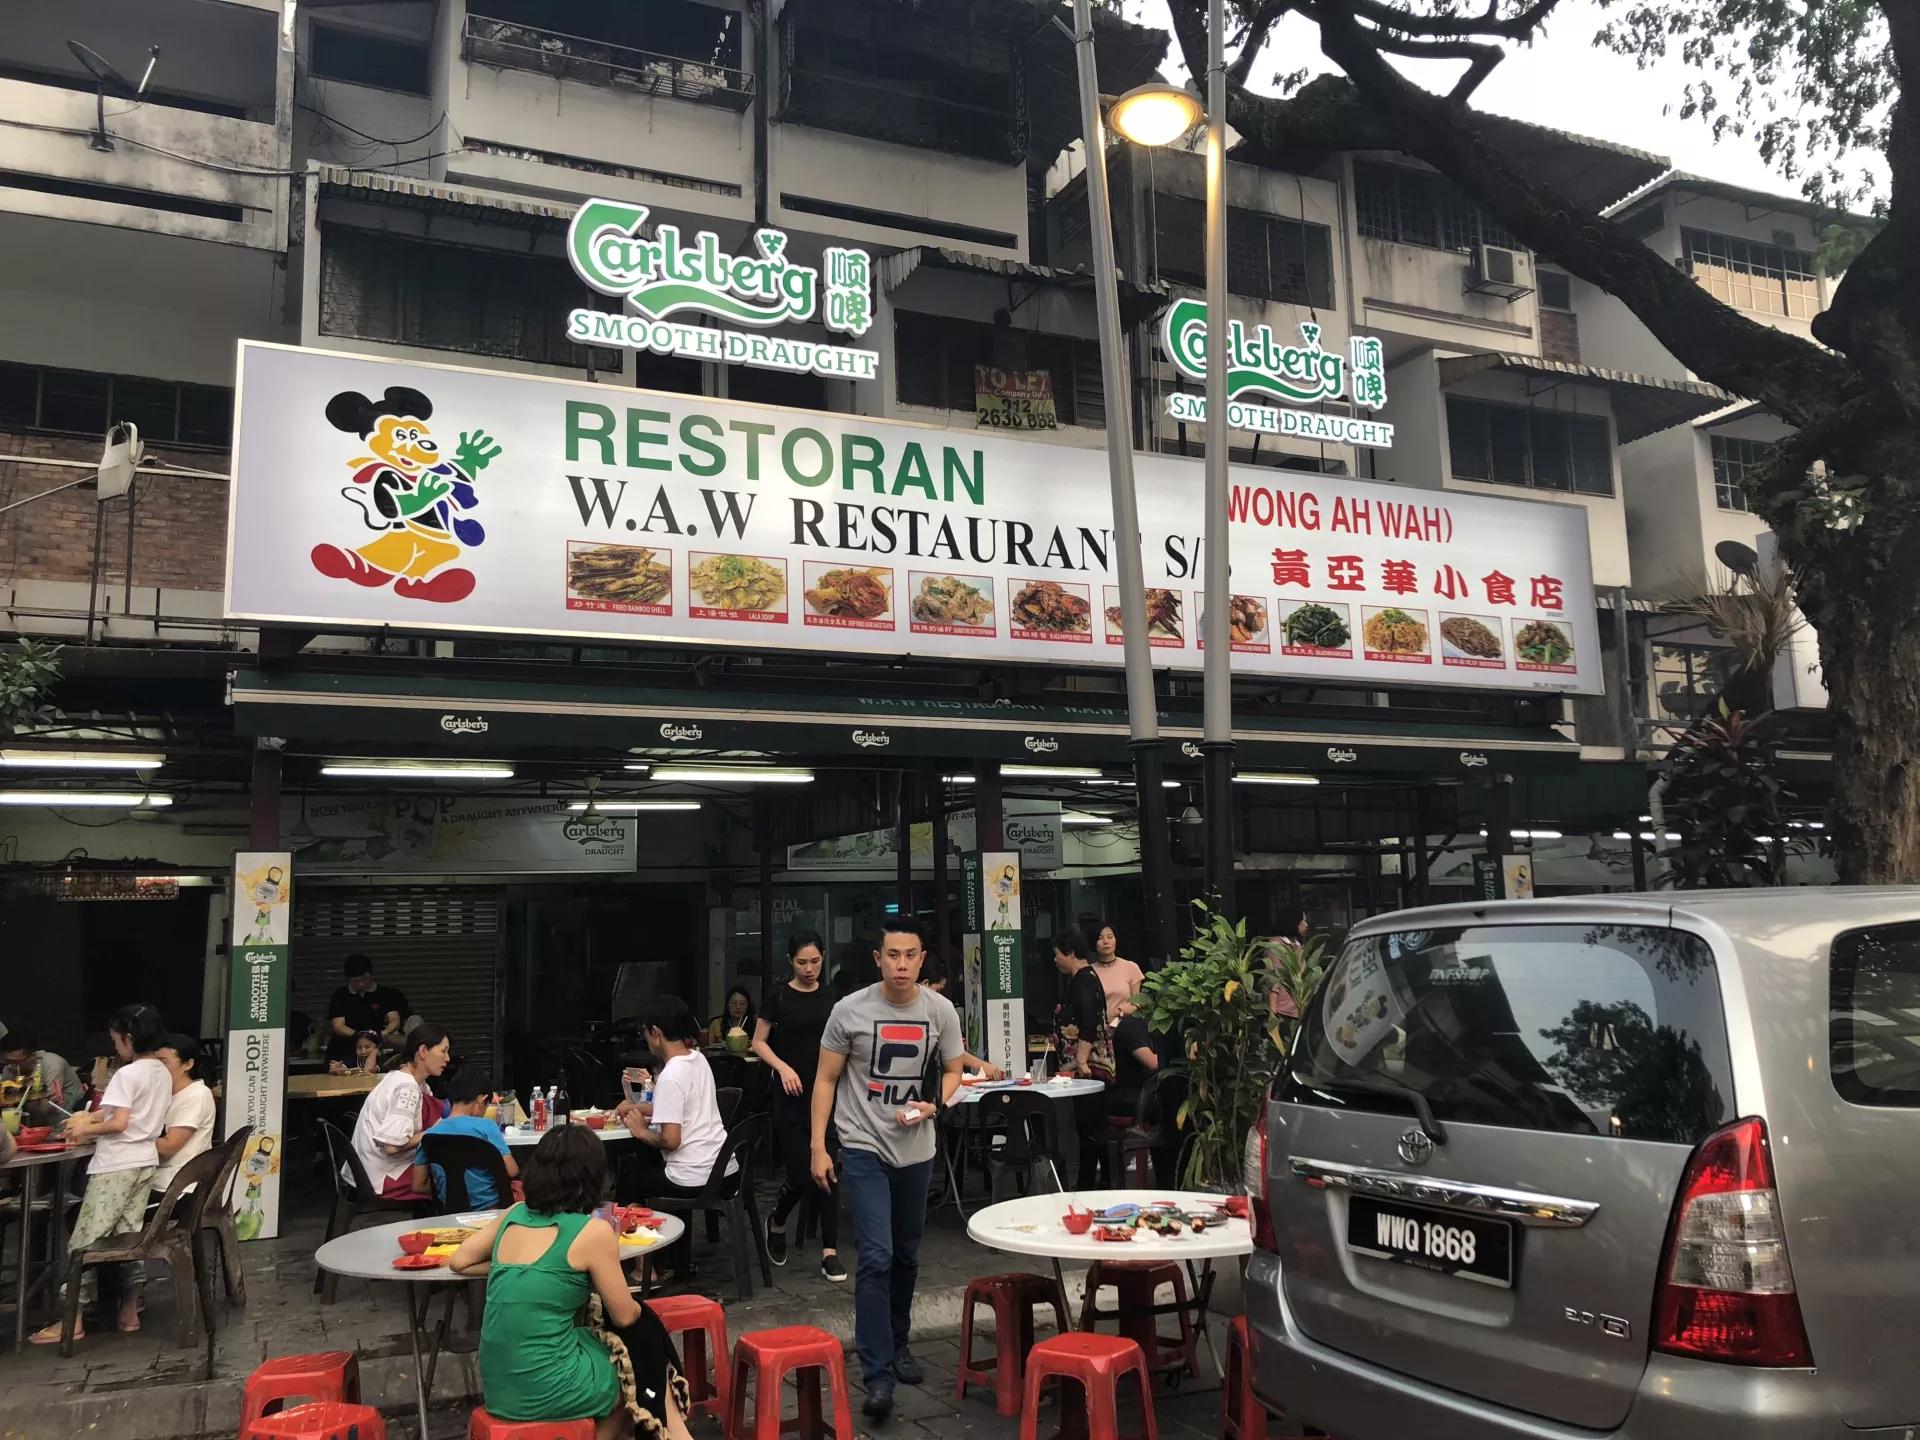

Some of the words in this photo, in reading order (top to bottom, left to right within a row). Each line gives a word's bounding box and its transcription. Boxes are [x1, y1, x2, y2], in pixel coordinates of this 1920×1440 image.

[568, 198, 817, 326] Carlsberg
[573, 314, 718, 355] SMOOTH
[728, 336, 875, 376] DRAUGHT
[1165, 299, 1343, 402] Calsberg
[978, 408, 1022, 426] 2630
[1173, 396, 1276, 428] SMOTH
[1284, 415, 1391, 444] DRAUGHT
[565, 399, 985, 506] RESTORAN
[565, 475, 757, 540] W.A.W
[788, 497, 1141, 573] RESTAURAN
[1165, 534, 1232, 580] S/
[1331, 496, 1371, 536] AH
[1377, 500, 1453, 544] WAH)
[441, 715, 488, 734] Carlsberg
[660, 723, 702, 741] Carlsberg
[852, 729, 890, 748] Carlsberg
[1024, 736, 1058, 752] Carlsberg
[450, 809, 503, 823] DRAUGHT
[563, 819, 625, 846] Carlsberg
[1005, 823, 1055, 845] Carlsberg
[585, 848, 624, 856] DRAUGHT
[245, 951, 277, 965] Carlsberg
[250, 974, 260, 1019] SMOOTH
[259, 973, 269, 1023] DRAUGHT
[246, 1034, 261, 1073] POP
[261, 1033, 270, 1083] ANYWHERE
[248, 1075, 256, 1094] CAN
[867, 1081, 921, 1106] FILA
[259, 1085, 268, 1128] DRAUGHT
[1376, 1212, 1420, 1252] WWQ
[1423, 1225, 1476, 1265] 1868
